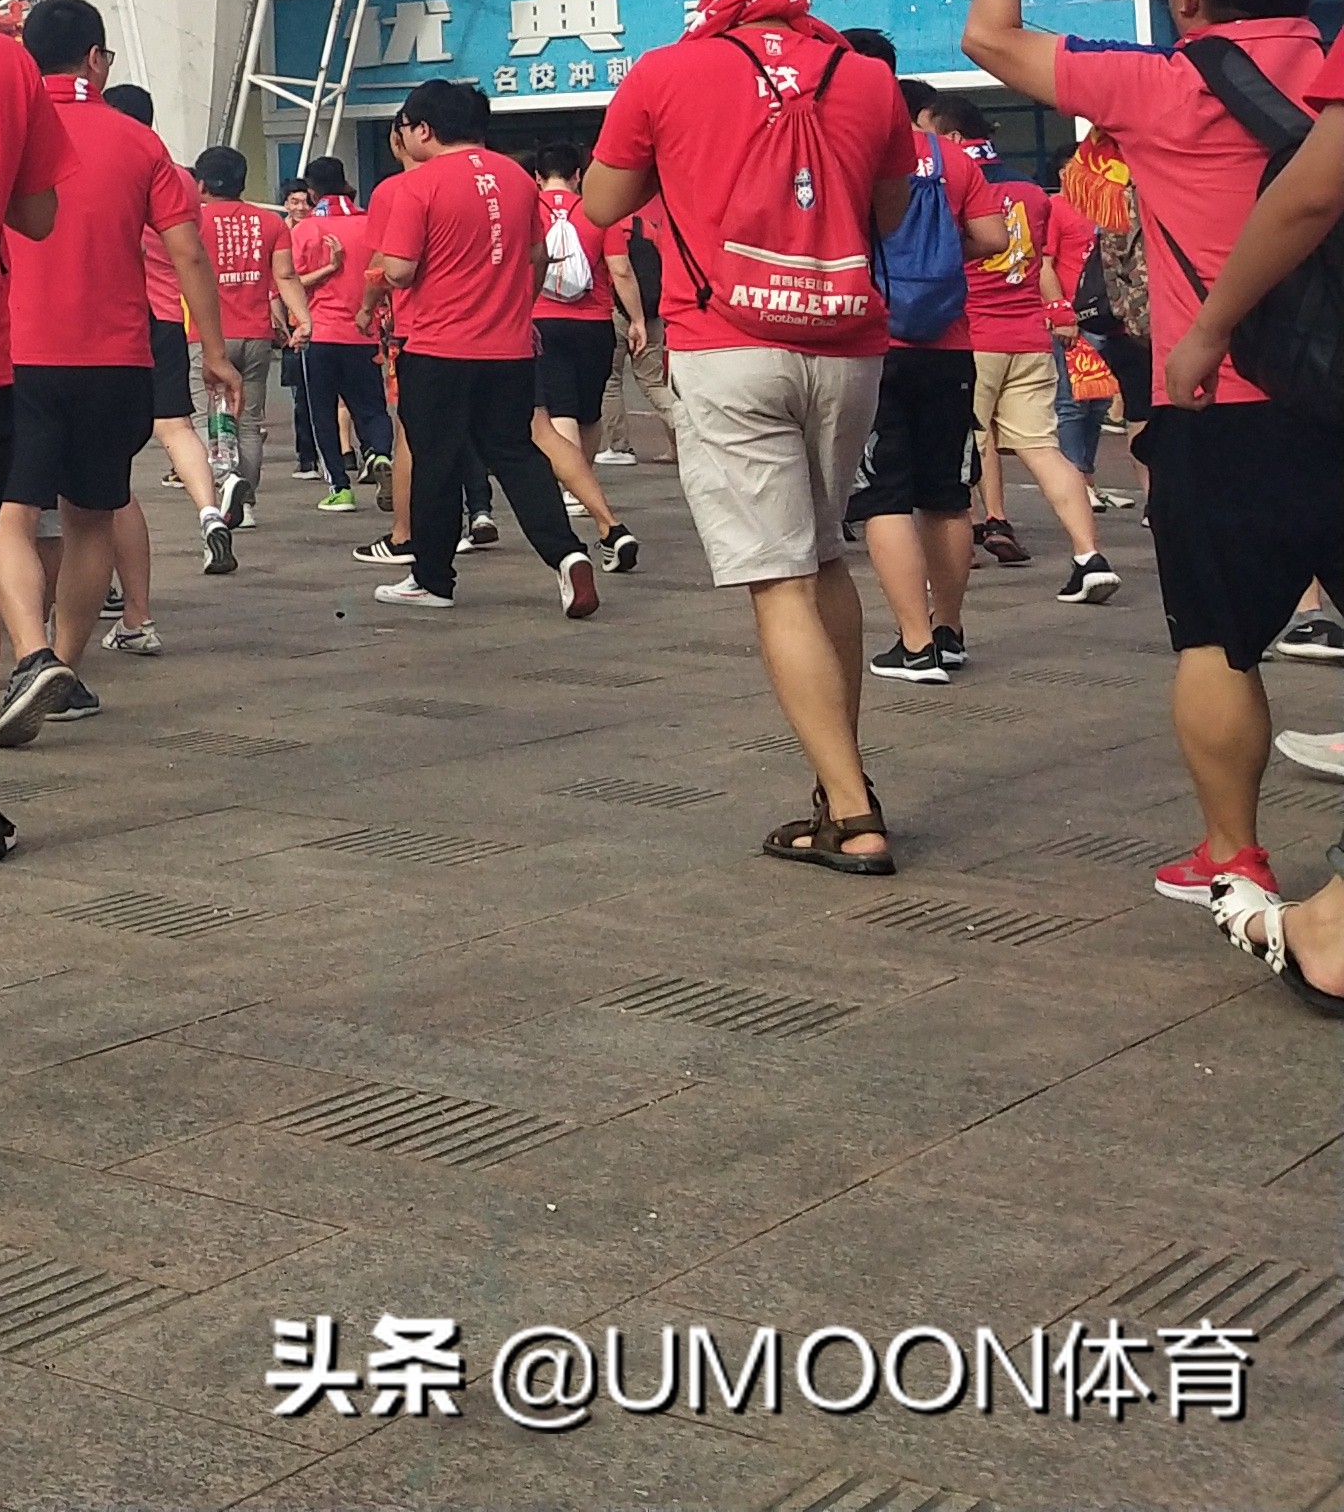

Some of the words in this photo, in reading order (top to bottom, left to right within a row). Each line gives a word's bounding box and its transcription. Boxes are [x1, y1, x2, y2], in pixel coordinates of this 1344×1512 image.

[492, 56, 633, 92] 名校冲刺
[728, 284, 869, 316] ATHLETIC
[759, 310, 808, 326] Football
